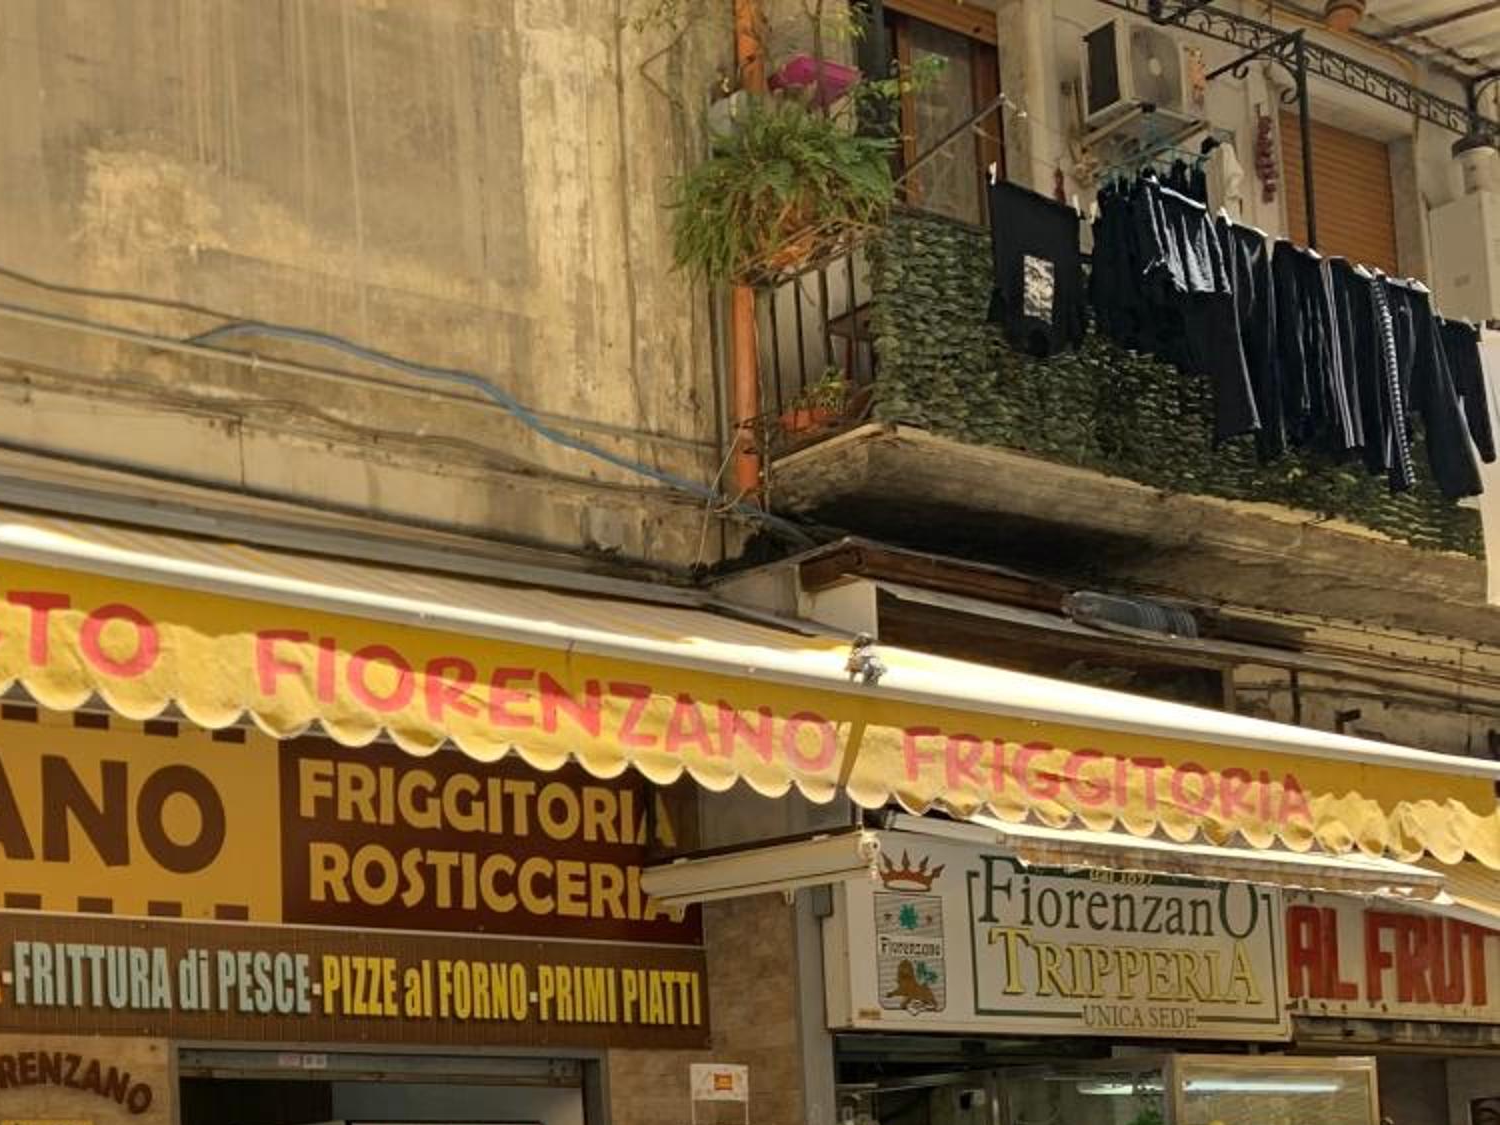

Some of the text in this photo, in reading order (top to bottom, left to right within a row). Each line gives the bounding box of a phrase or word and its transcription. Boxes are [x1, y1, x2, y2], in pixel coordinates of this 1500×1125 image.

[254, 627, 837, 773] FIORENZANO
[902, 725, 1312, 825] FRIGGITORIA
[178, 950, 210, 1012] di
[404, 958, 431, 1018] al
[622, 968, 706, 1027] PIATTI
[988, 926, 1263, 1005] TRIPPERIA
[1285, 905, 1359, 1002] AL
[1082, 1003, 1199, 1030] UNICA SEDE
